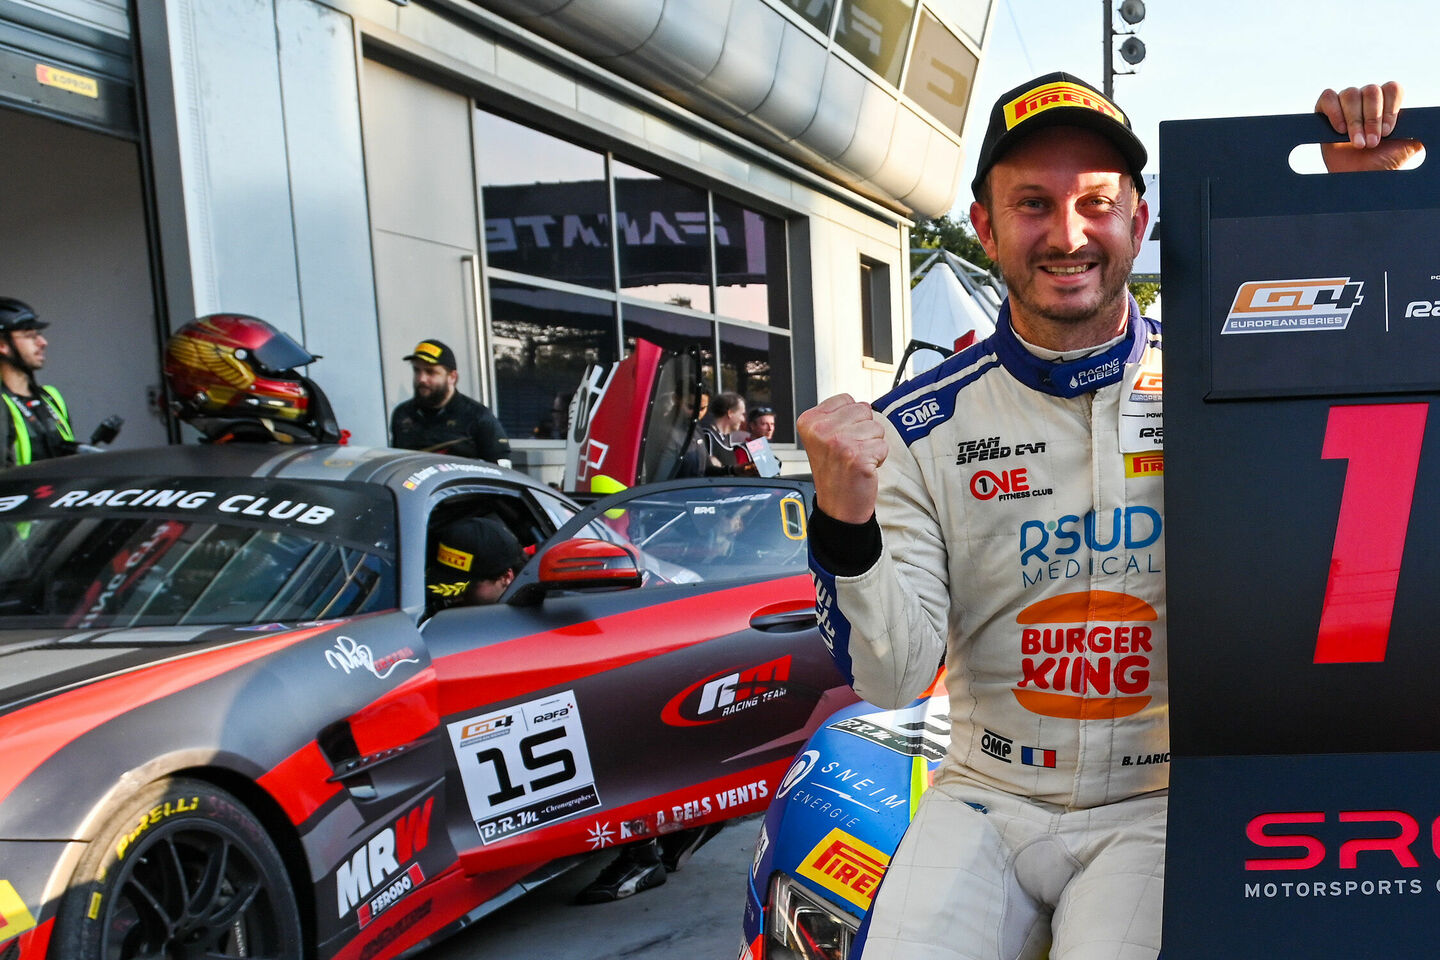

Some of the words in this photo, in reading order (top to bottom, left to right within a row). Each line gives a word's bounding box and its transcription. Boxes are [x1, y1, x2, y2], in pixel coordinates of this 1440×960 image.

[1230, 318, 1299, 329] EUROPEAN
[1300, 316, 1343, 326] SERIES
[1078, 358, 1120, 379] RACING
[1079, 365, 1120, 386] LUBES
[901, 401, 940, 426] OMP
[956, 446, 1011, 466] SPEED
[1015, 442, 1046, 456] CAR
[957, 436, 1000, 454] TEAM
[50, 489, 216, 509] RACING
[218, 495, 335, 525] CLUB
[999, 491, 1031, 502] FITNESS
[1032, 488, 1053, 497] CLUB
[1313, 402, 1430, 664] 1
[1022, 553, 1162, 589] MEDICAL
[1021, 626, 1153, 655] BURGER
[1017, 655, 1150, 696] KING
[722, 697, 759, 717] RACING
[762, 687, 787, 703] TEAM
[980, 733, 1013, 759] OMP
[1122, 755, 1133, 766] B.
[476, 725, 577, 807] 15
[716, 780, 769, 811] VENTS
[821, 761, 906, 809] SNEIM
[793, 790, 861, 828] ENERGIE
[369, 875, 412, 916] FERODO
[1244, 879, 1423, 898] MOTORSPORTS
